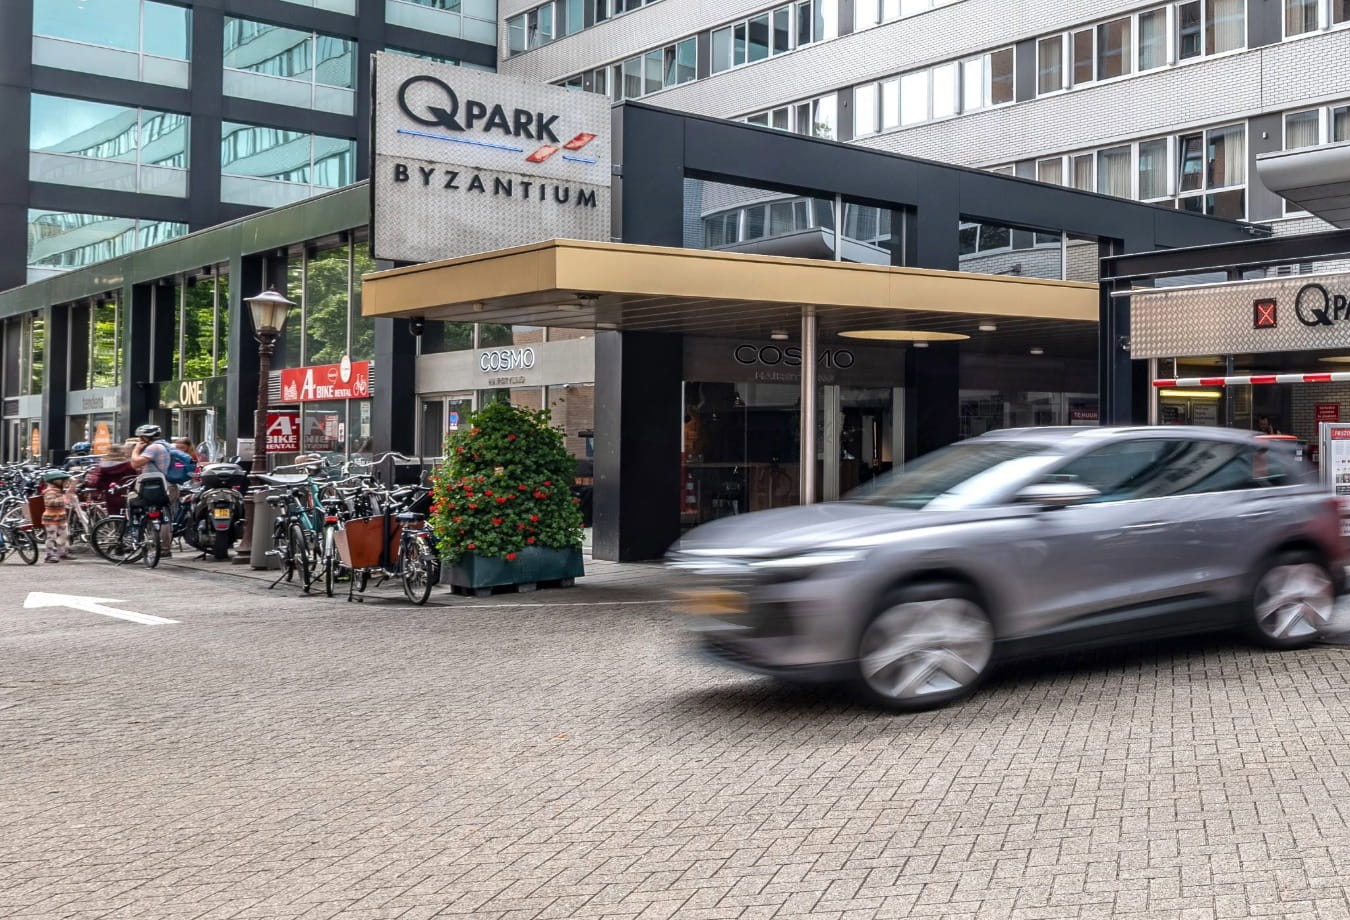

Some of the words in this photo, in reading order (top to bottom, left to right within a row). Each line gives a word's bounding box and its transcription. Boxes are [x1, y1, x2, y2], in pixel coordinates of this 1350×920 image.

[394, 163, 598, 208] BYZANTIUM
[480, 347, 535, 372] COSMO
[180, 381, 203, 405] ONE
[316, 385, 334, 399] BIKE
